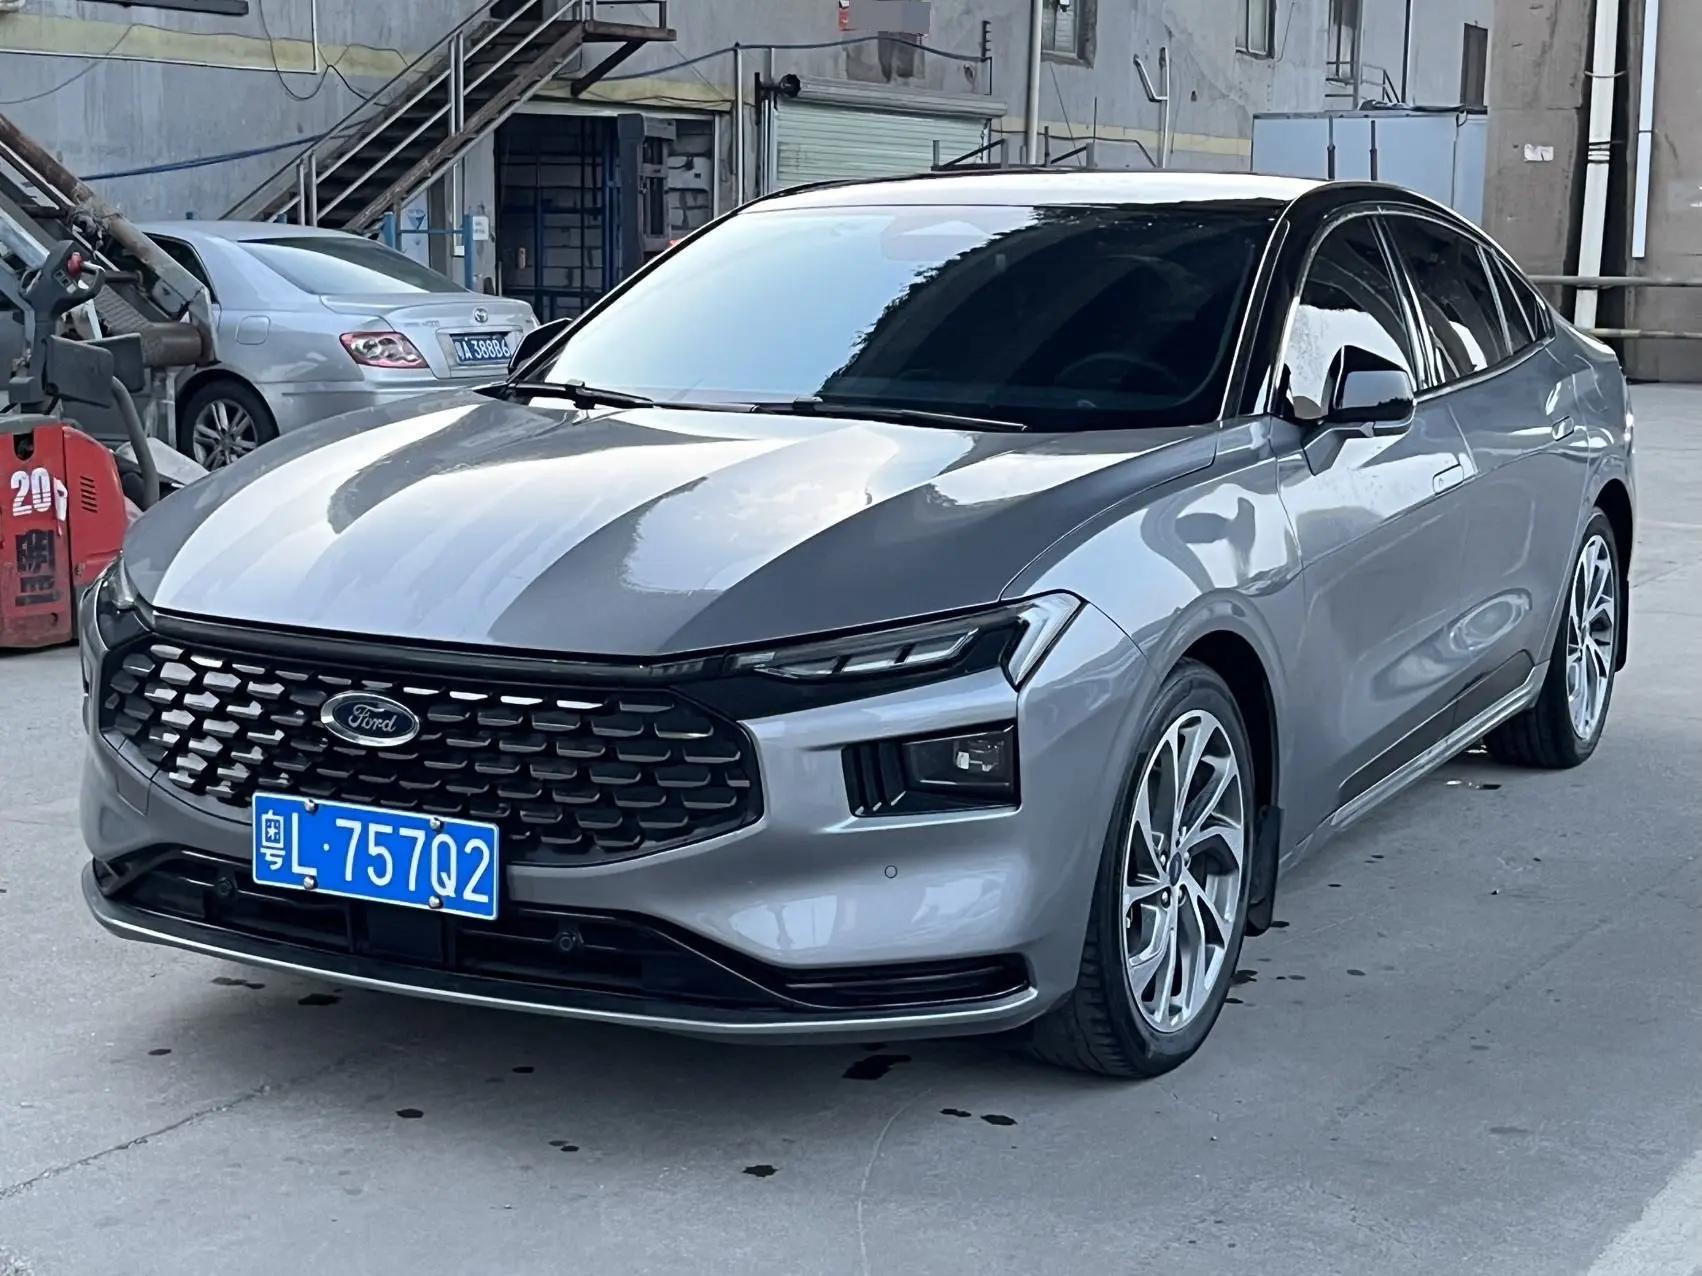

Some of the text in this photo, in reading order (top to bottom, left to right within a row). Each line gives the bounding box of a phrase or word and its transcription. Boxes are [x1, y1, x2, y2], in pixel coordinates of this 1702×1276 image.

[455, 339, 510, 360] A388B6
[11, 467, 51, 516] 20
[348, 704, 398, 732] Ford
